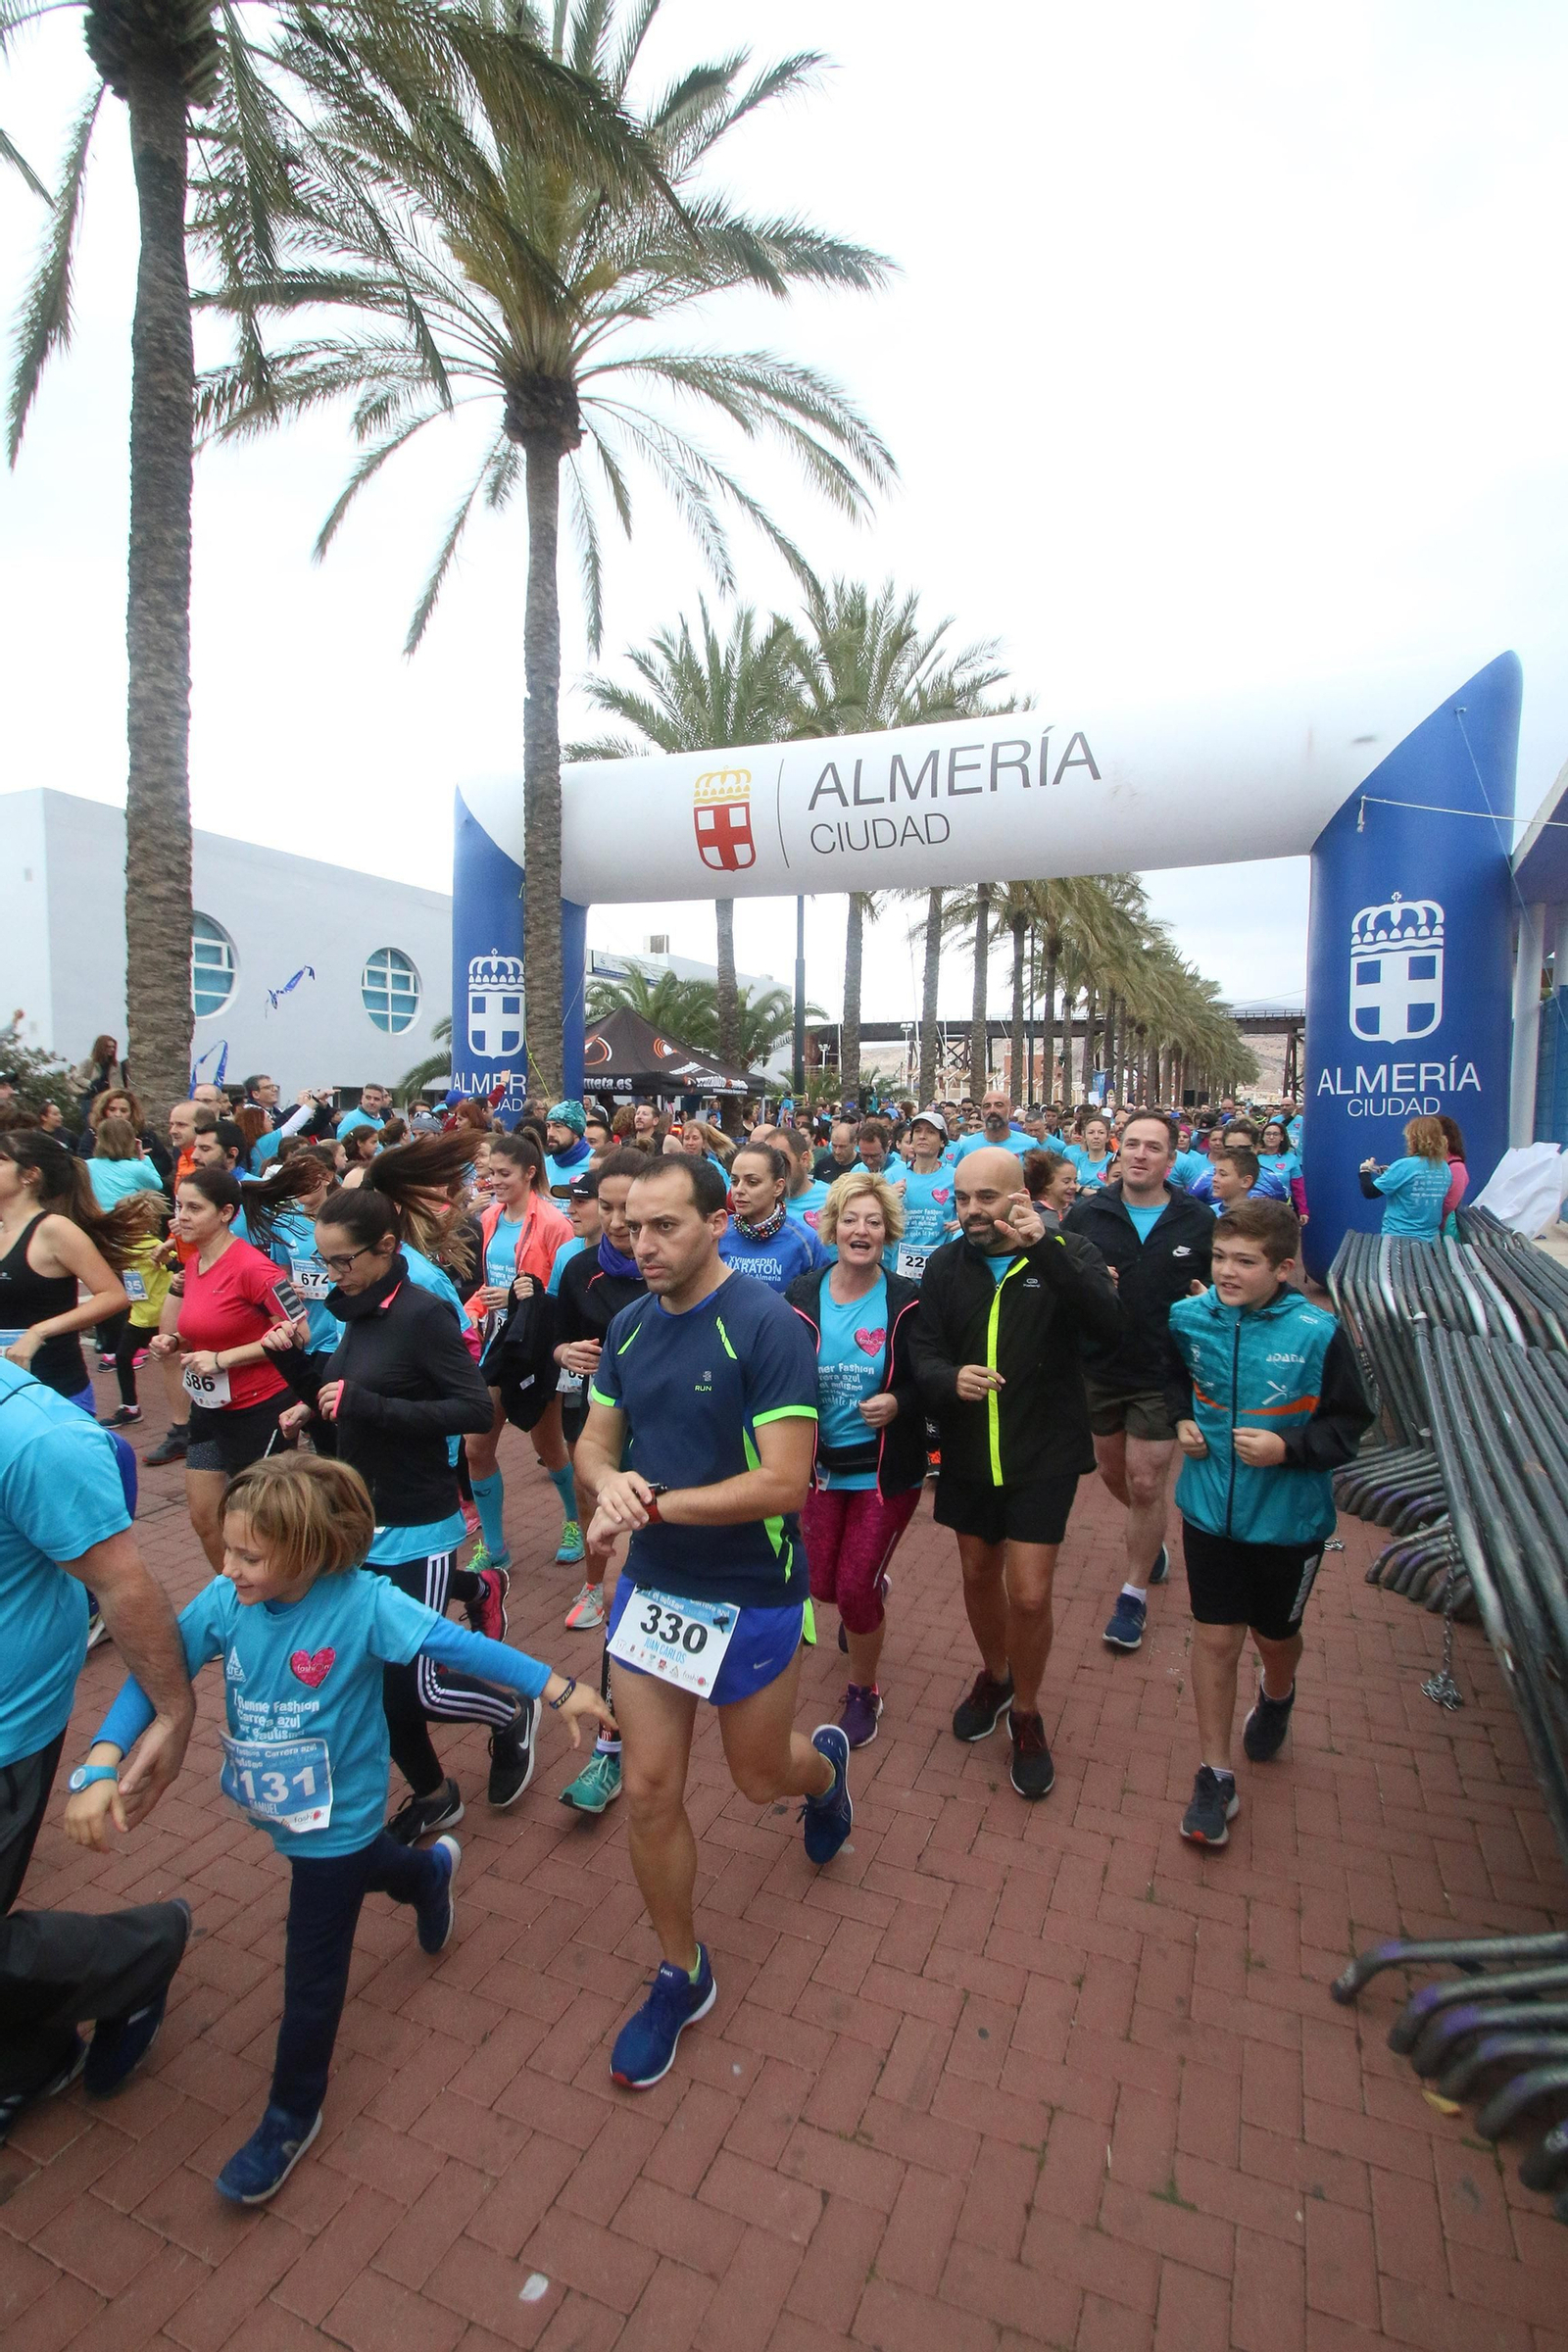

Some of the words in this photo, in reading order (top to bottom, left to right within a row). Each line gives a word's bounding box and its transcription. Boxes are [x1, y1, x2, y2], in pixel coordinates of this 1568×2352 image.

[808, 725, 1102, 811] ALMERÍA
[809, 812, 951, 855] CIUDAD
[1316, 1054, 1482, 1097] ALMERÍA
[1347, 1097, 1441, 1117] CIUDAD
[905, 1255, 930, 1269] 22
[838, 1362, 875, 1375] Fashion
[842, 1373, 861, 1383] azul
[640, 1603, 709, 1655] 330
[643, 1637, 660, 1652] JUAN
[659, 1641, 687, 1665] CARLOS
[273, 1700, 320, 1714] Fashion
[237, 1708, 273, 1728] Carrea
[277, 1714, 301, 1729] azul
[265, 1747, 299, 1758] Carrera
[300, 1742, 318, 1753] azul
